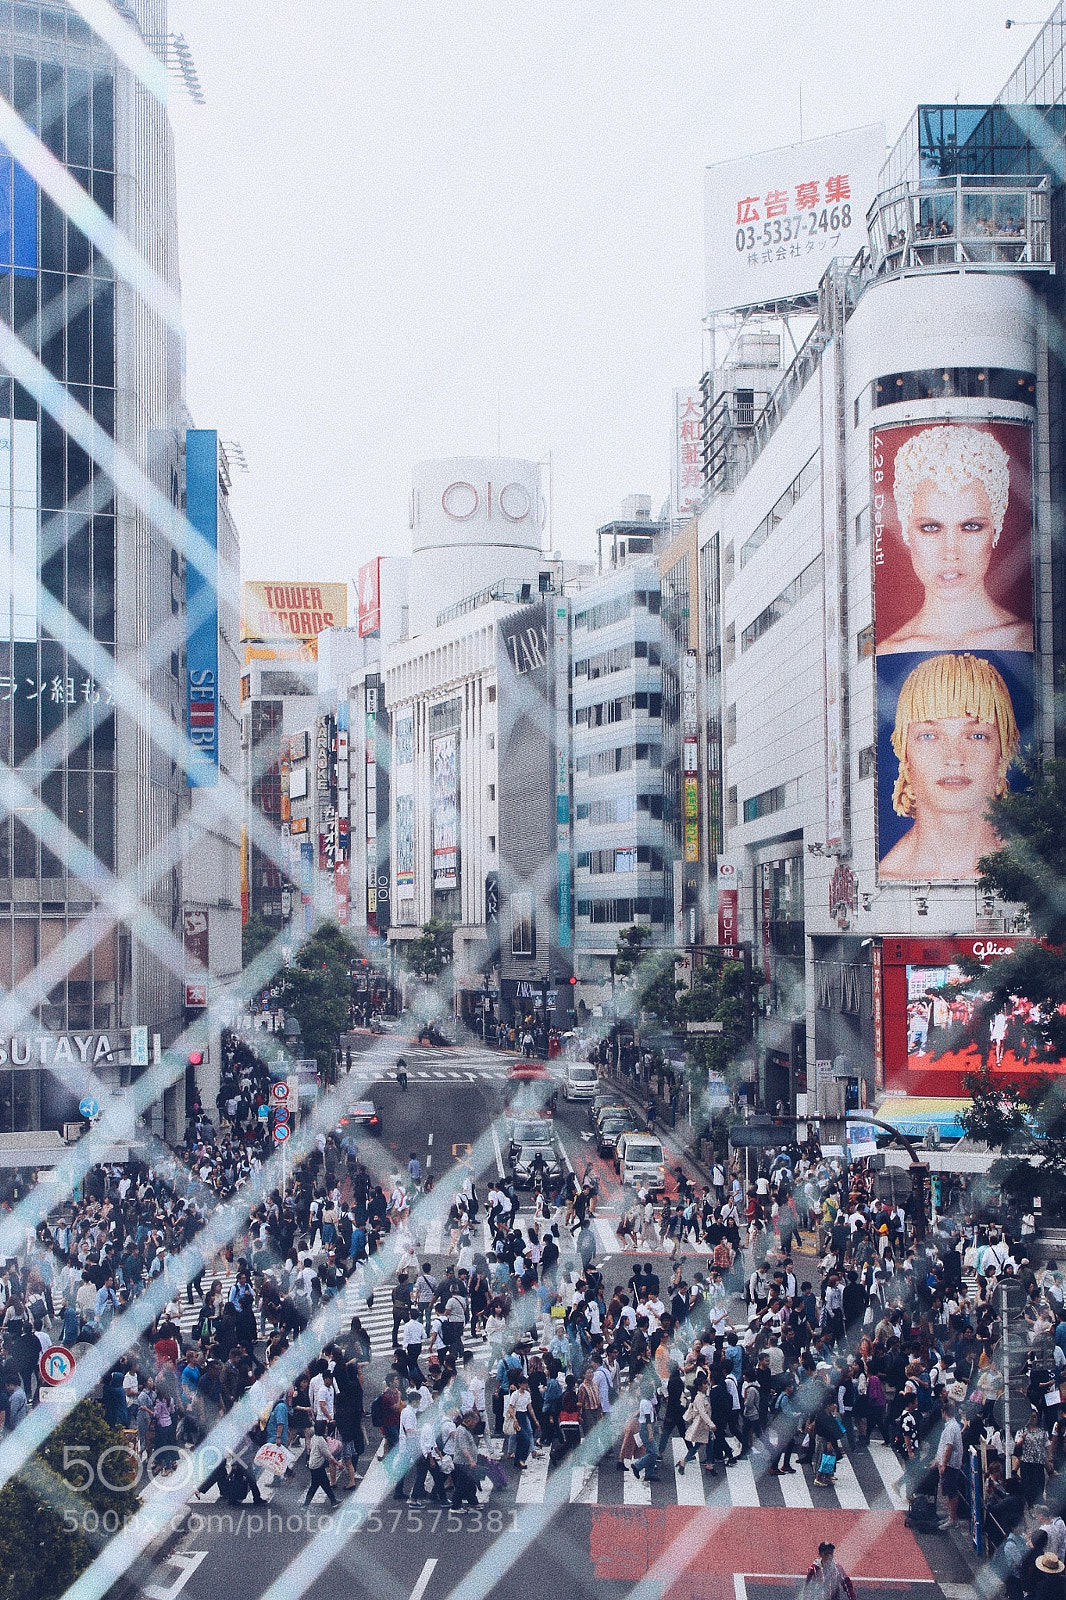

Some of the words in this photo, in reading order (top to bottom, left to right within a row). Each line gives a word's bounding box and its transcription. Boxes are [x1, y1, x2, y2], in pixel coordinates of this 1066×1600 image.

[736, 174, 851, 225] 広告募集
[735, 203, 852, 252] 03-5337-2468
[873, 436, 884, 483] 4.28
[263, 586, 323, 610] TOWER
[258, 611, 335, 635] RECORDS
[190, 669, 215, 764] SEIBU
[317, 715, 328, 790] KARAOKE
[487, 880, 498, 924] ZARA
[973, 941, 1015, 960] Glico
